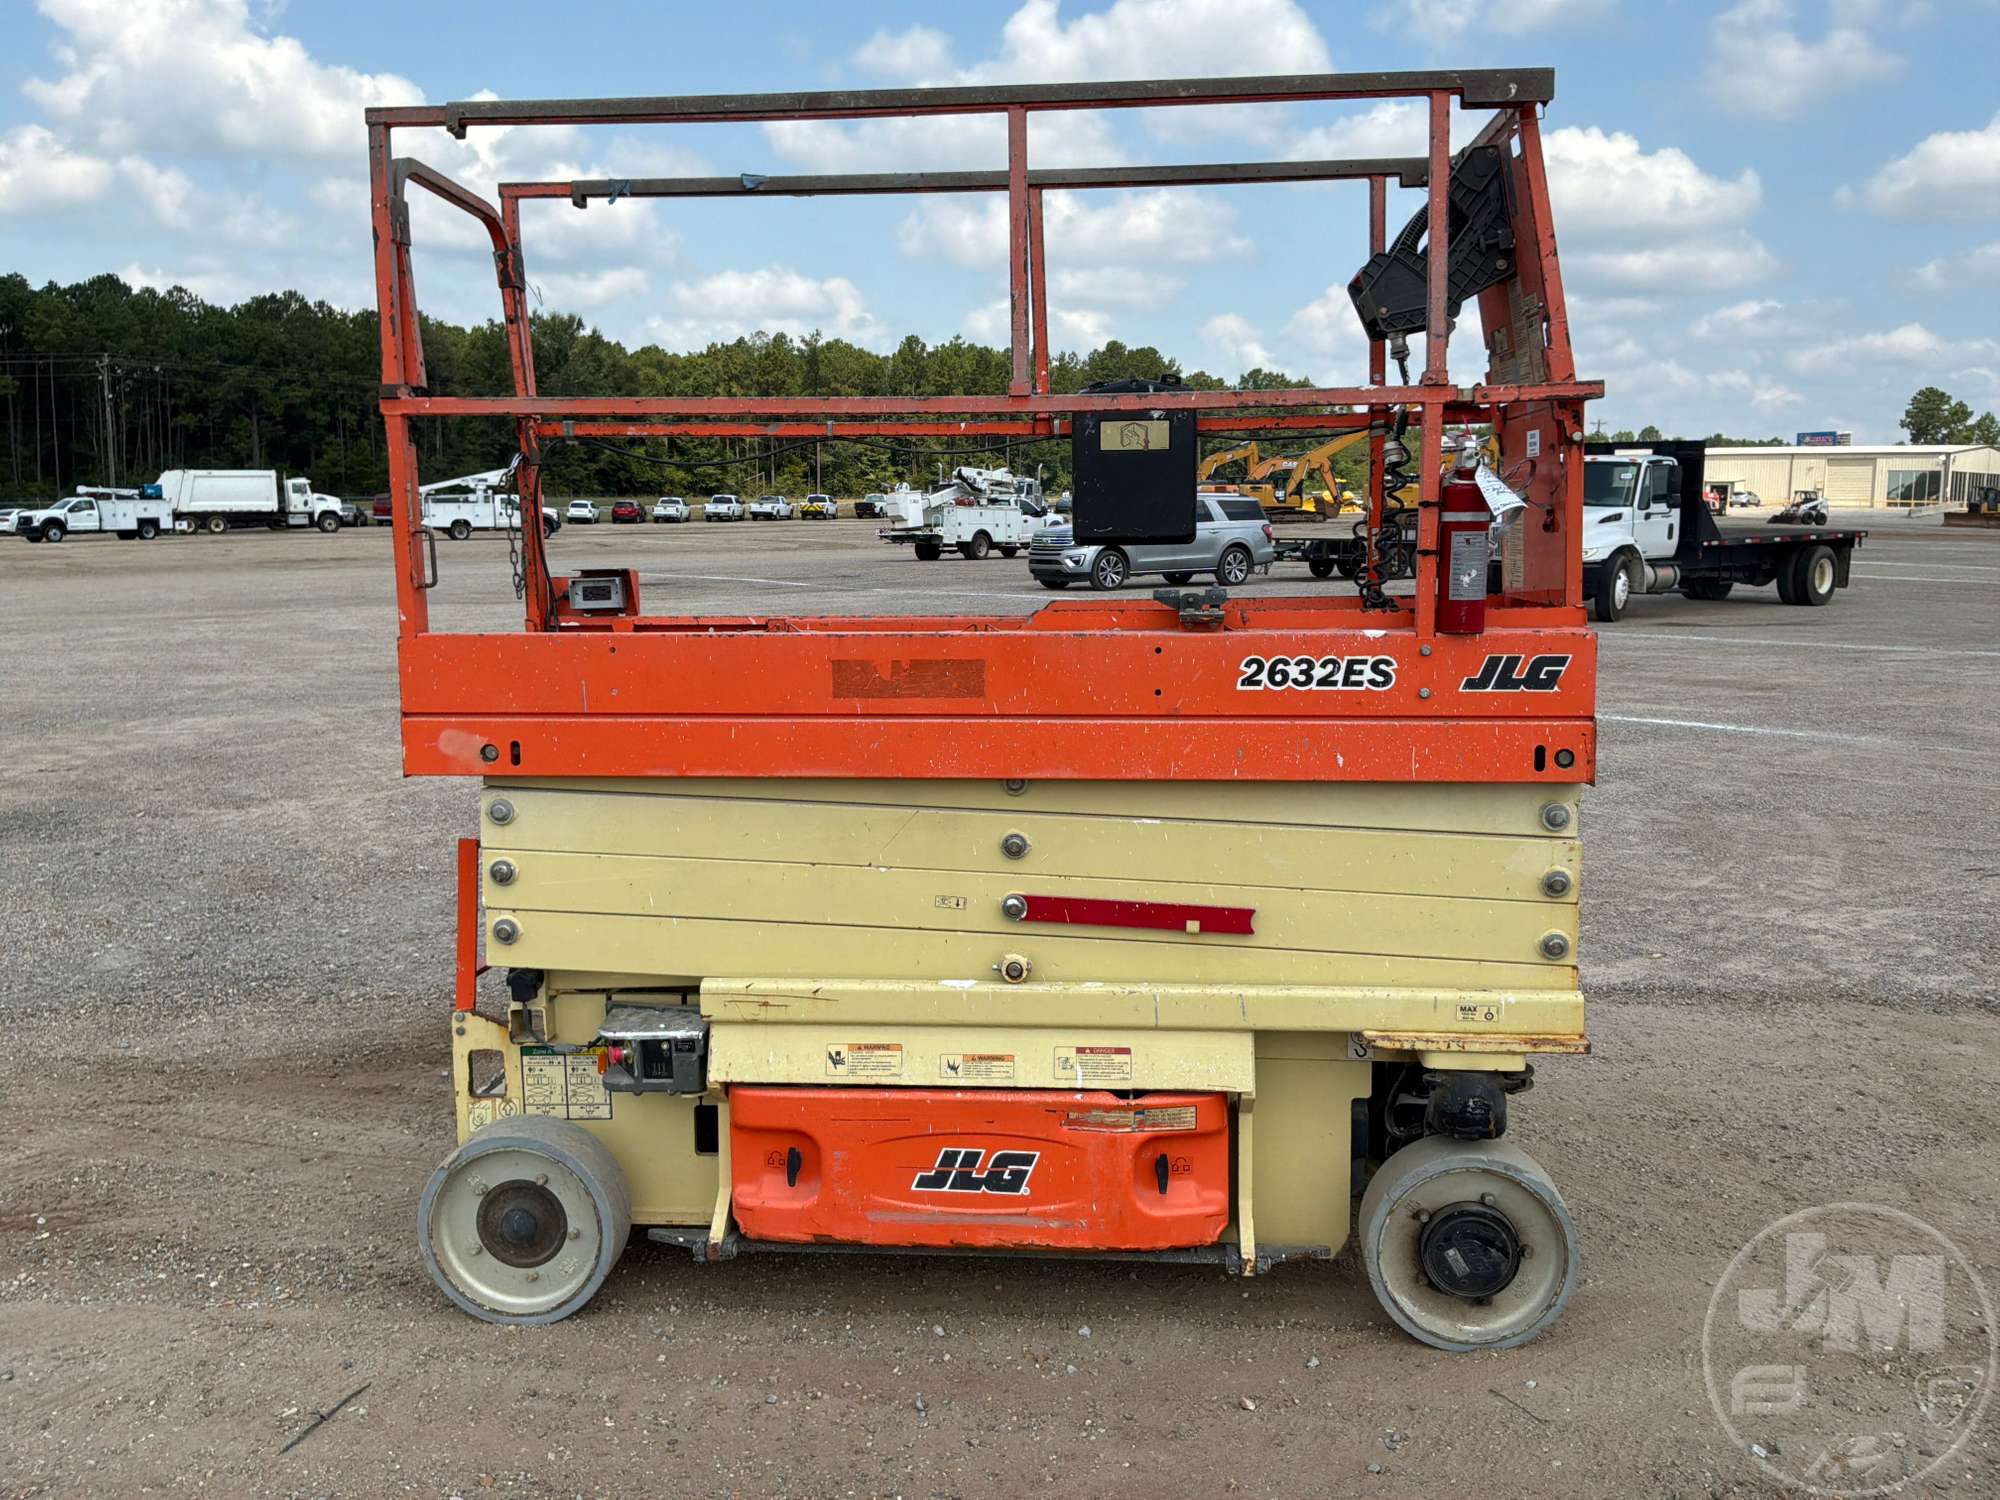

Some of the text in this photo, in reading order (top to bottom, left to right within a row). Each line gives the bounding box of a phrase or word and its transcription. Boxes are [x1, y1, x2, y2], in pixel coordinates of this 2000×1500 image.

[1238, 655, 1398, 691] 2632ES
[1459, 654, 1572, 692] JLG
[911, 1147, 1040, 1195] JLG
